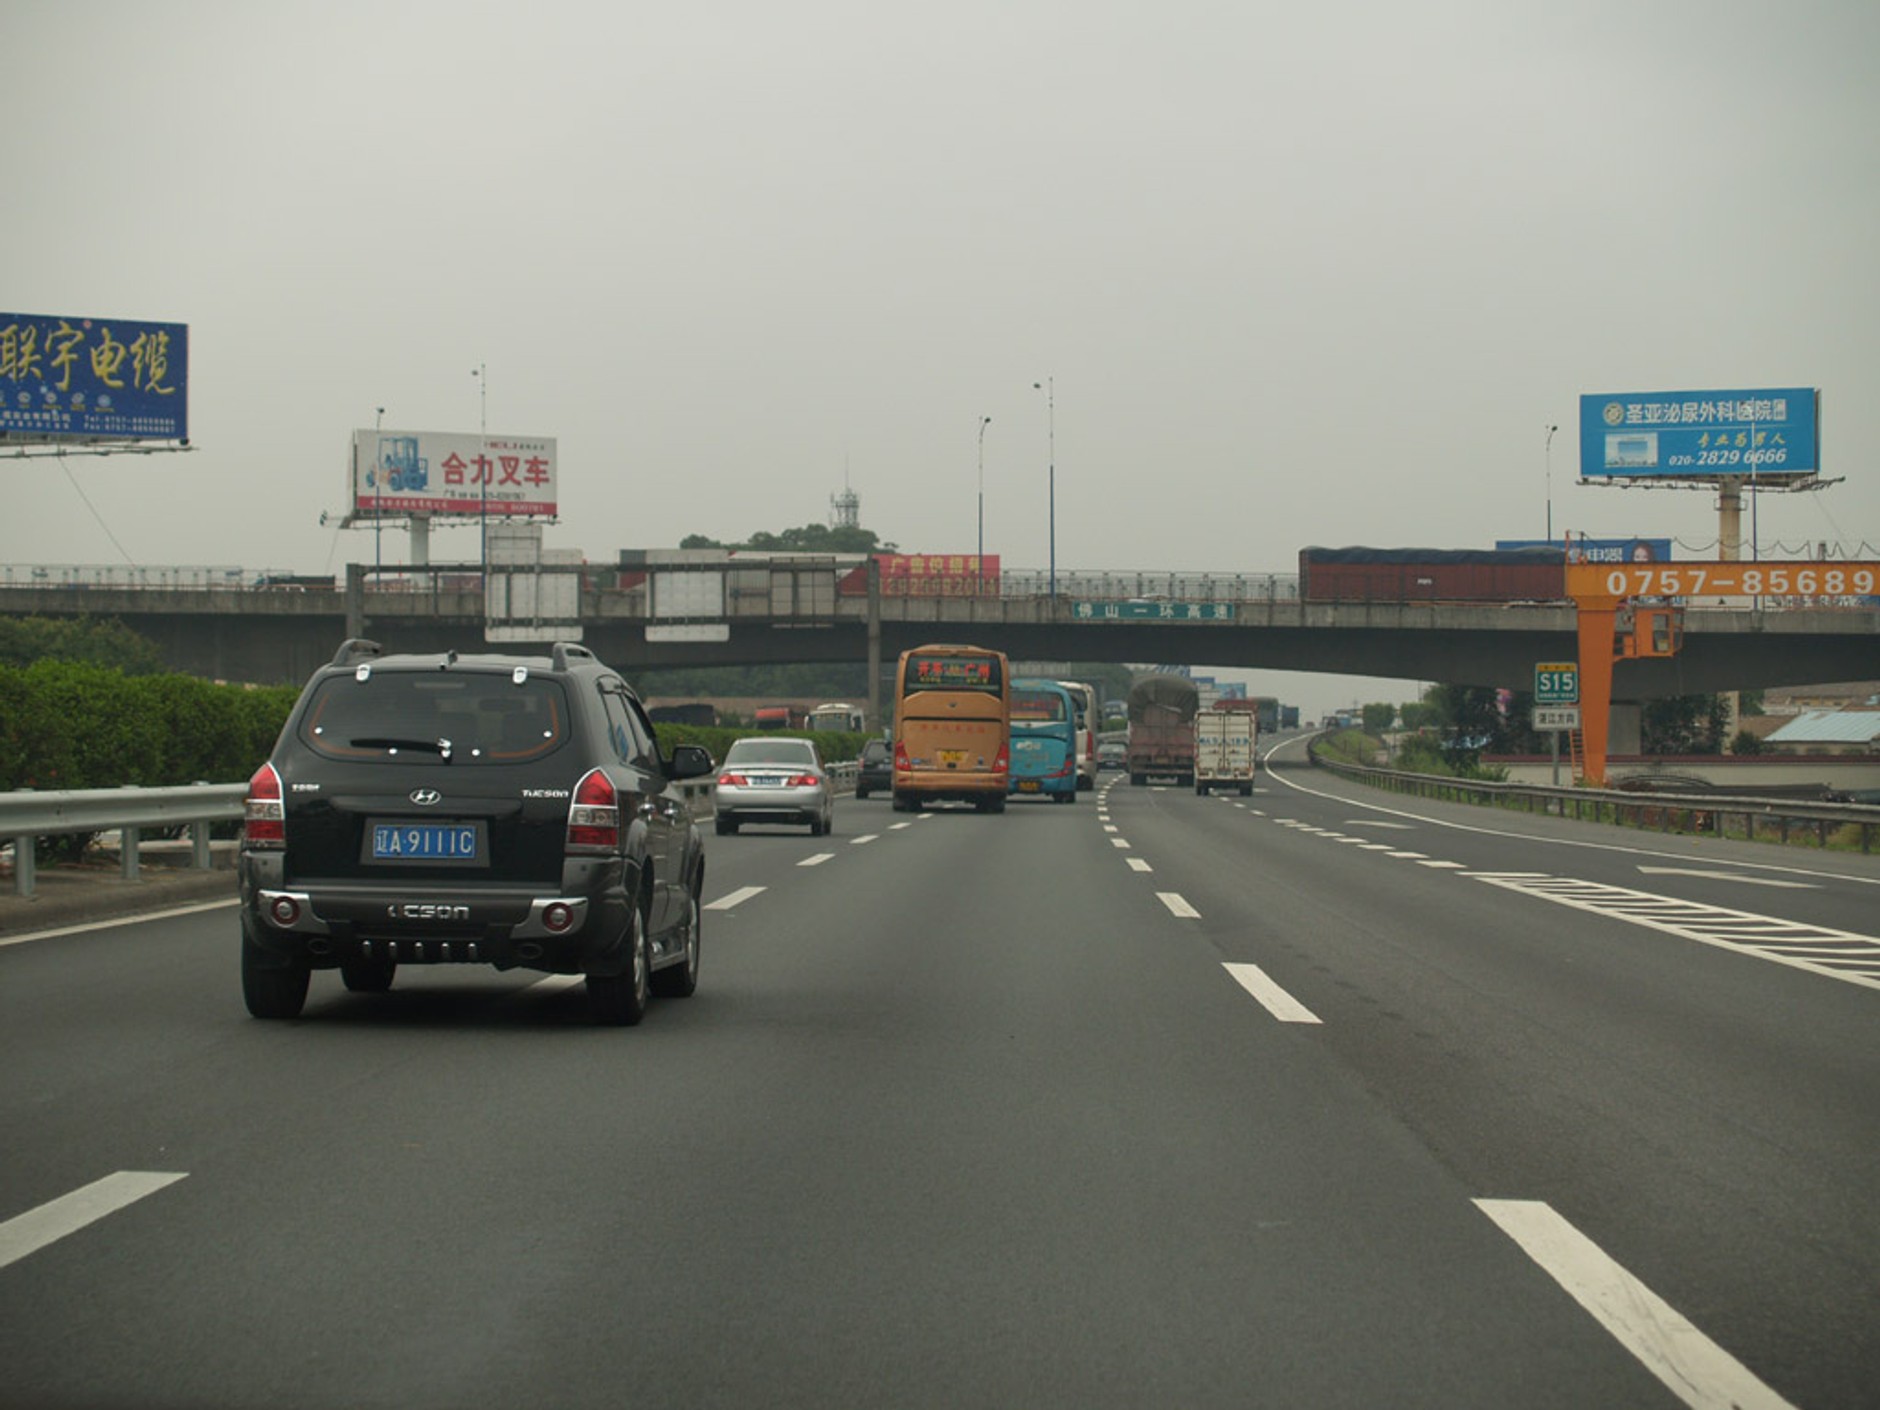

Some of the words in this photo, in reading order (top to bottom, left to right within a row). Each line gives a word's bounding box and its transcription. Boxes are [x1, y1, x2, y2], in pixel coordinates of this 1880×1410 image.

[442, 451, 551, 488] 合力叉车
[1078, 602, 1228, 619] 佛山一环高速
[1540, 673, 1573, 691] S15
